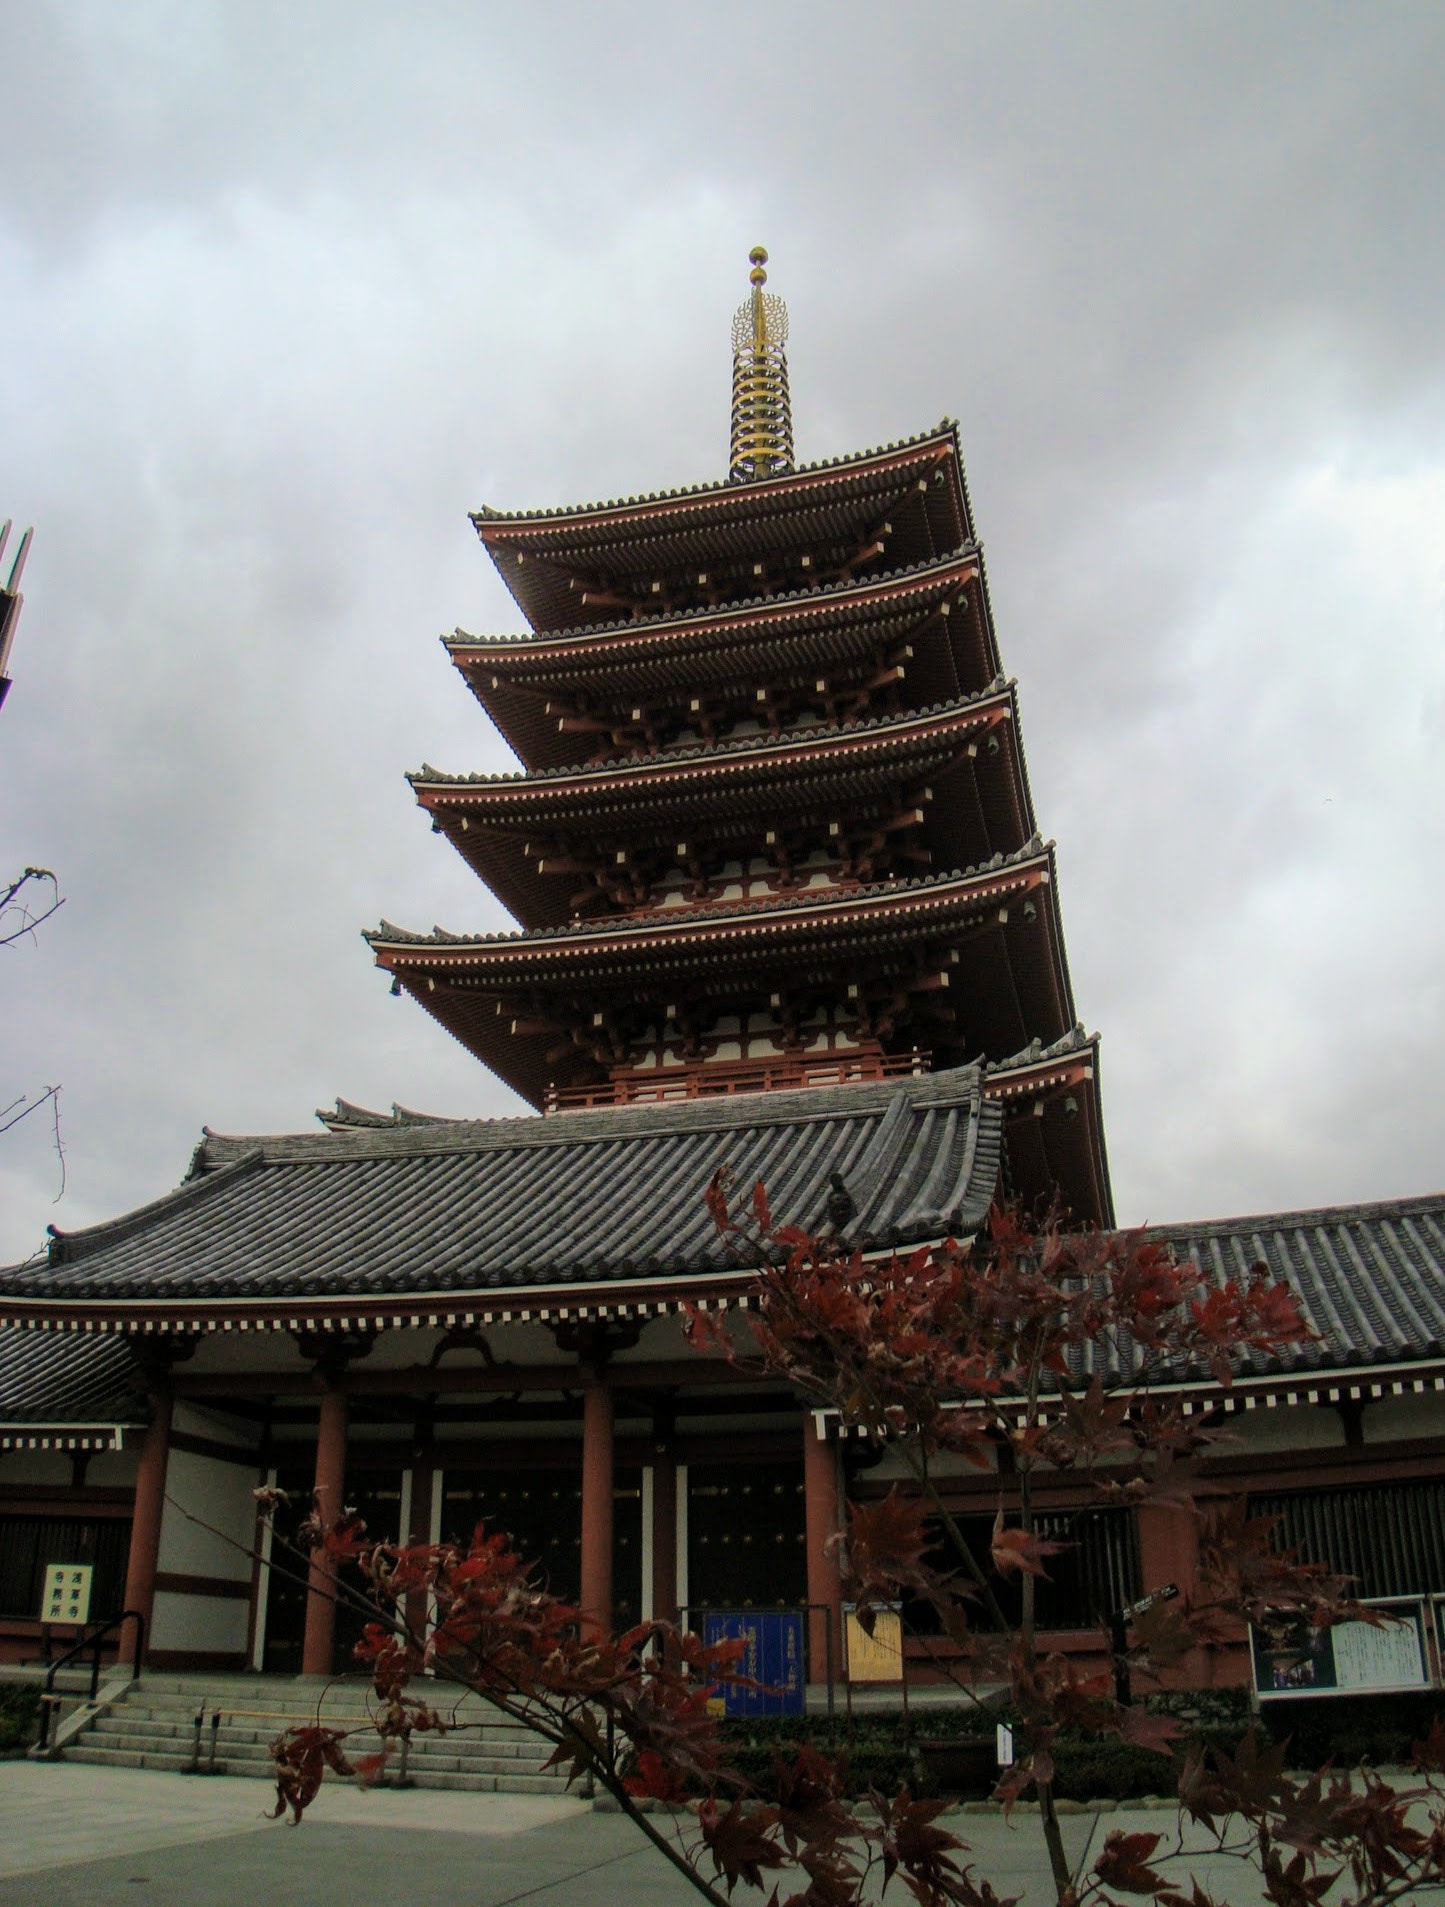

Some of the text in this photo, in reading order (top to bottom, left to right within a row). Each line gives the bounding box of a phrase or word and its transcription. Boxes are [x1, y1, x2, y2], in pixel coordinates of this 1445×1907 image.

[50, 1571, 64, 1617] 寺務所
[69, 1571, 82, 1618] 浅草寺
